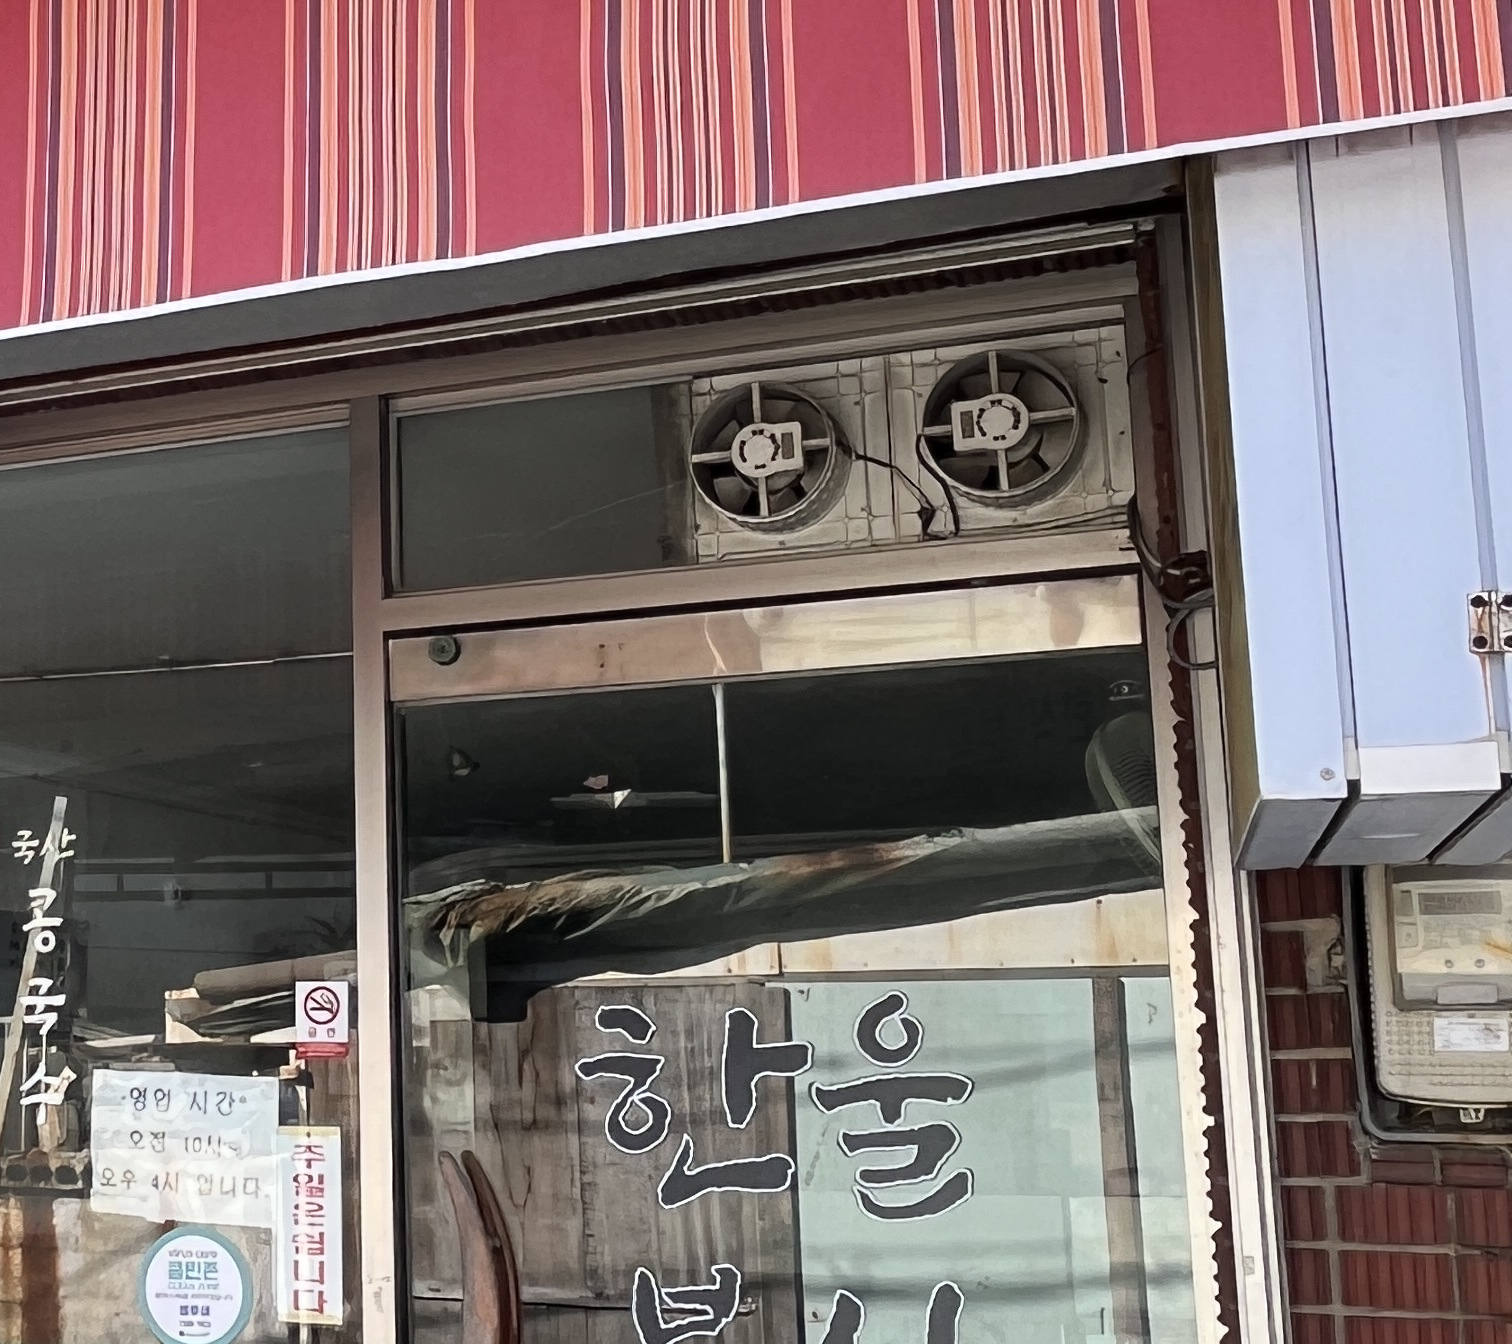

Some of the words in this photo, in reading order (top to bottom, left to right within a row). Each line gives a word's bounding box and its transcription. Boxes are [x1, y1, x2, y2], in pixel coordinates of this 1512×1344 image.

[130, 1087, 171, 1113] 영업
[189, 1090, 236, 1117] 시간
[575, 990, 973, 1221] 한울
